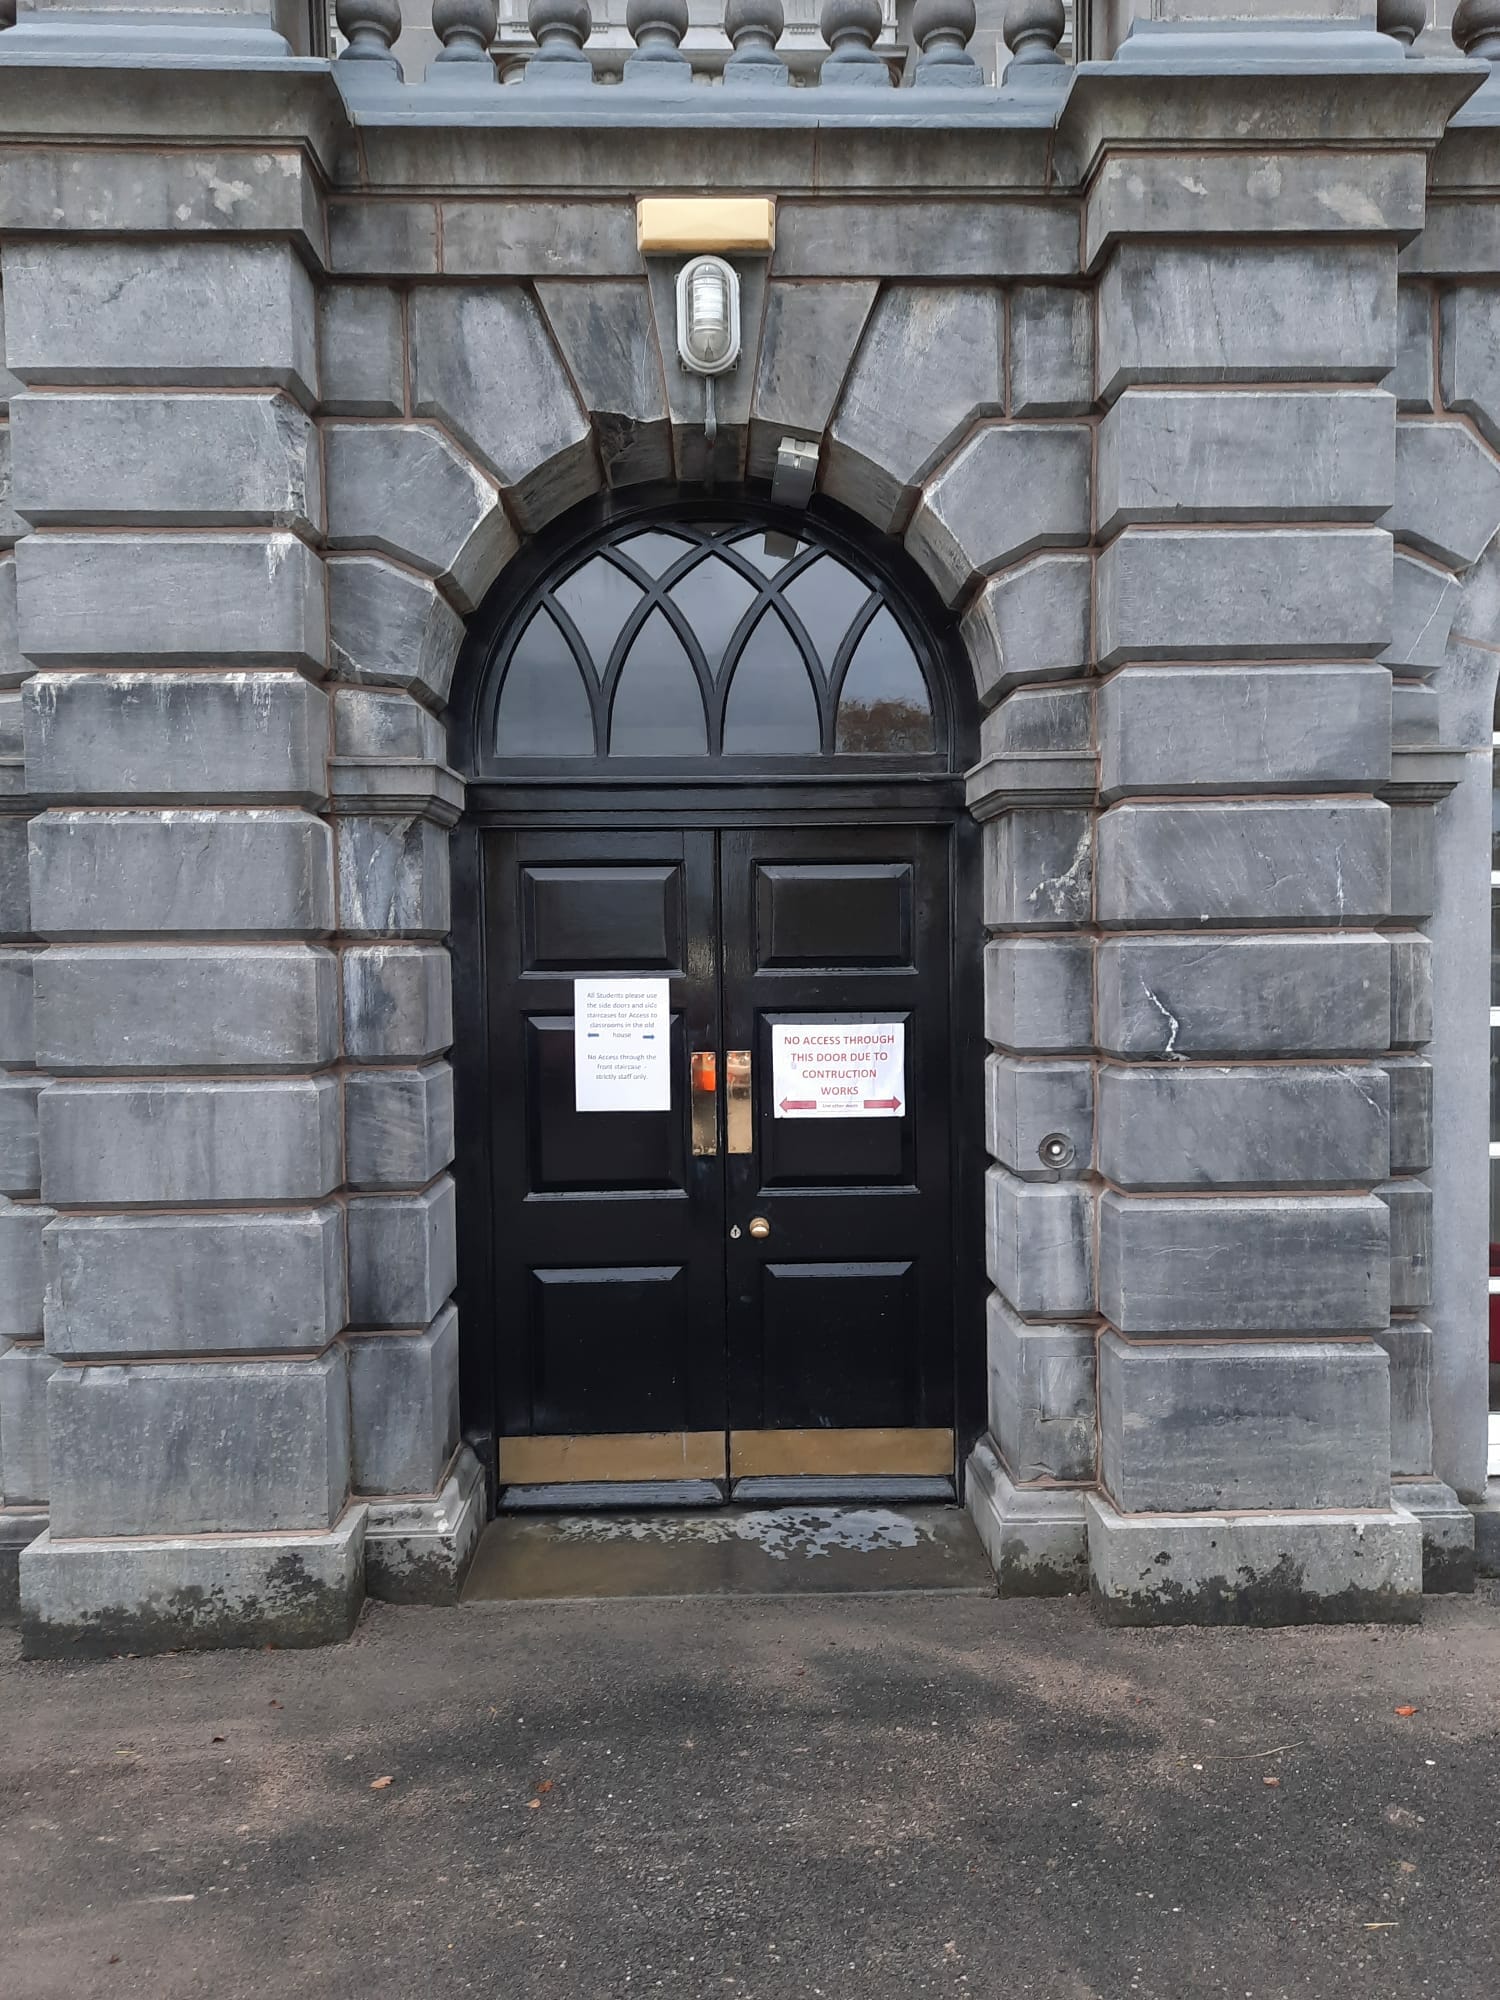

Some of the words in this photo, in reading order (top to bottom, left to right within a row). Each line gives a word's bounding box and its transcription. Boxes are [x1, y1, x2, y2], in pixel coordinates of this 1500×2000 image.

[625, 992, 645, 1000] please
[784, 1036, 800, 1045] NO
[803, 1036, 841, 1045] ACCESS
[843, 1035, 895, 1044] THROUGH
[620, 1054, 645, 1062] through
[791, 1053, 814, 1062] THIS
[817, 1053, 847, 1061] DOOR
[850, 1052, 871, 1061] DUE
[874, 1052, 888, 1061] TO
[596, 1073, 617, 1081] strictly
[802, 1069, 877, 1078] CONTRUCTION
[821, 1086, 859, 1095] WORKS
